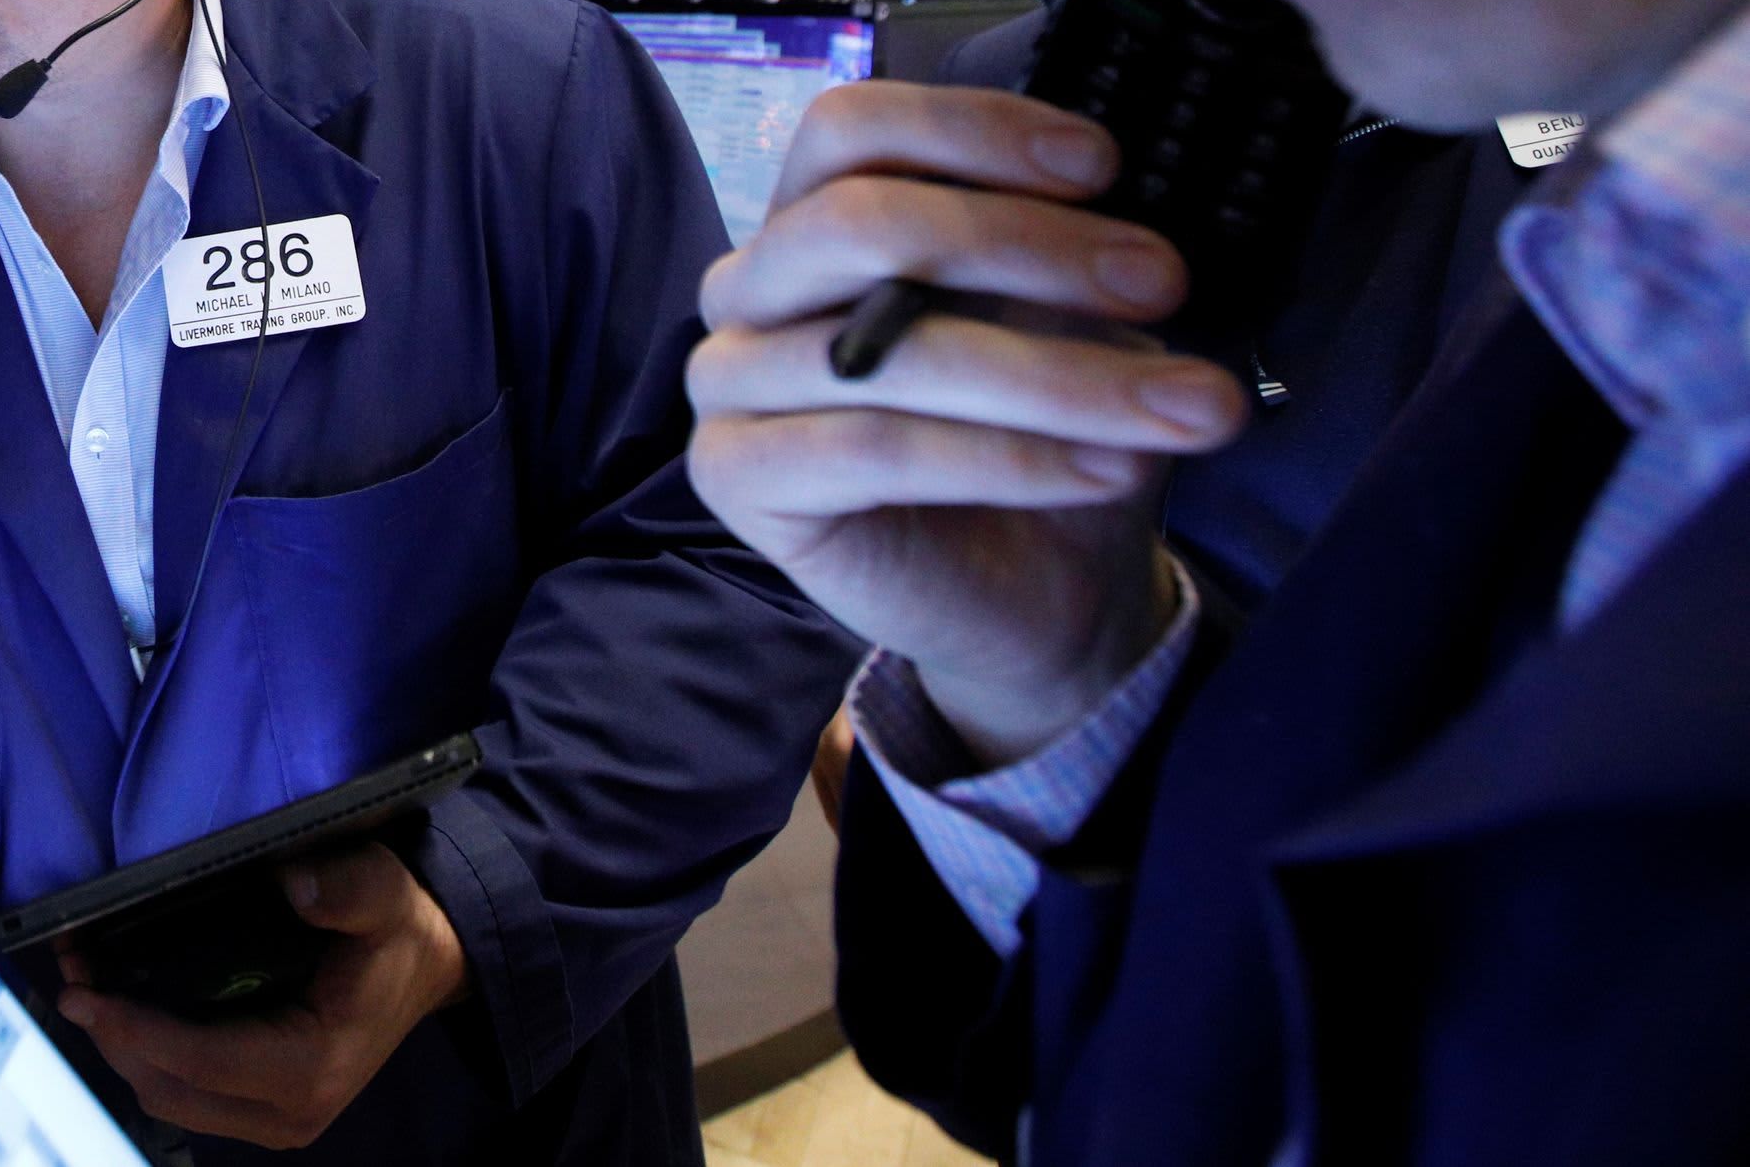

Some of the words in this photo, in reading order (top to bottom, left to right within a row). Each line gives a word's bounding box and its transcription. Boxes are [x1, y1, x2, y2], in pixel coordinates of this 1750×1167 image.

[1532, 141, 1579, 160] QUAT
[202, 232, 314, 291] 286
[196, 293, 253, 314] MICHAEL
[281, 281, 331, 300] MILANO
[179, 322, 236, 341] LIVERMORE
[336, 304, 357, 317] INC.
